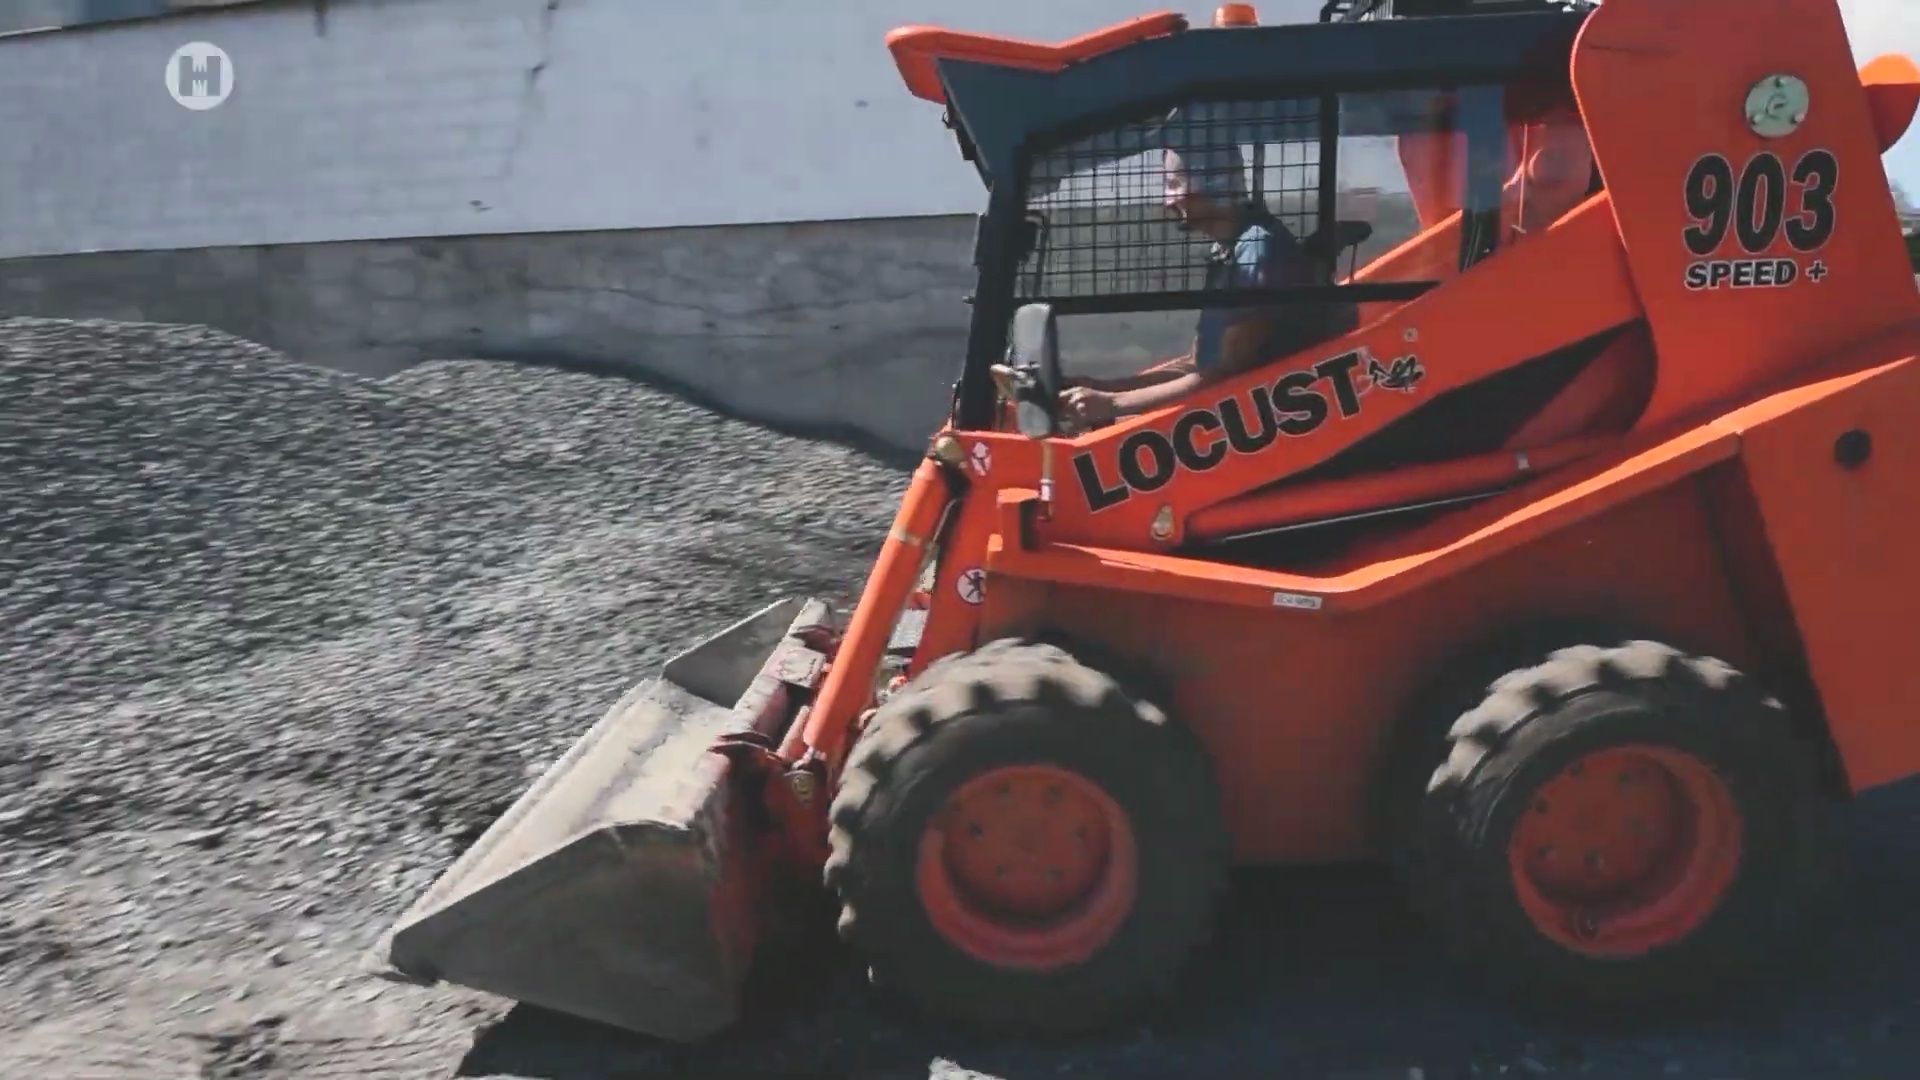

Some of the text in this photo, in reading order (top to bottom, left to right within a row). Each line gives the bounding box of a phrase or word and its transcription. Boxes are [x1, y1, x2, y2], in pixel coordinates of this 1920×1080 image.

[1683, 149, 1839, 255] 903
[1684, 258, 1798, 290] SPEED
[1073, 347, 1364, 514] LOCUST
